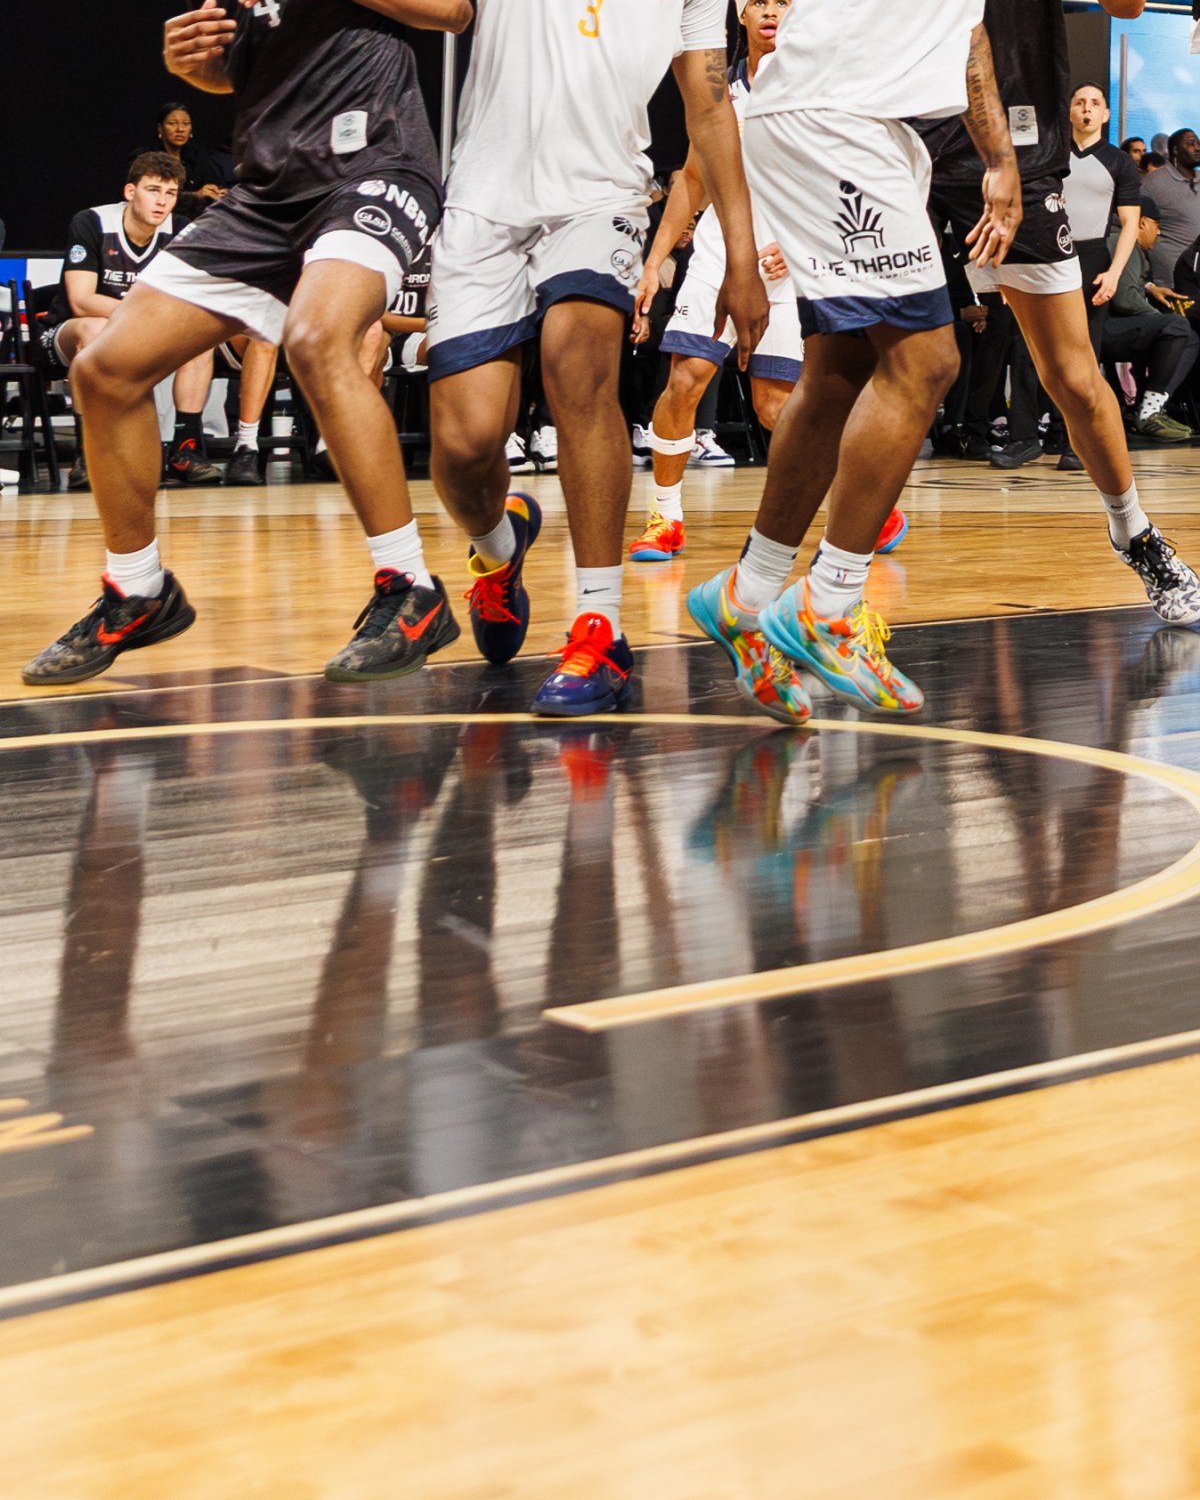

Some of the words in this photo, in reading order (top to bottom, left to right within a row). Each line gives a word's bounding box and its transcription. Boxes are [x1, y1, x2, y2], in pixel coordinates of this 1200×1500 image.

[385, 184, 429, 246] NBPA
[851, 245, 932, 274] THRONE
[391, 290, 418, 315] 10
